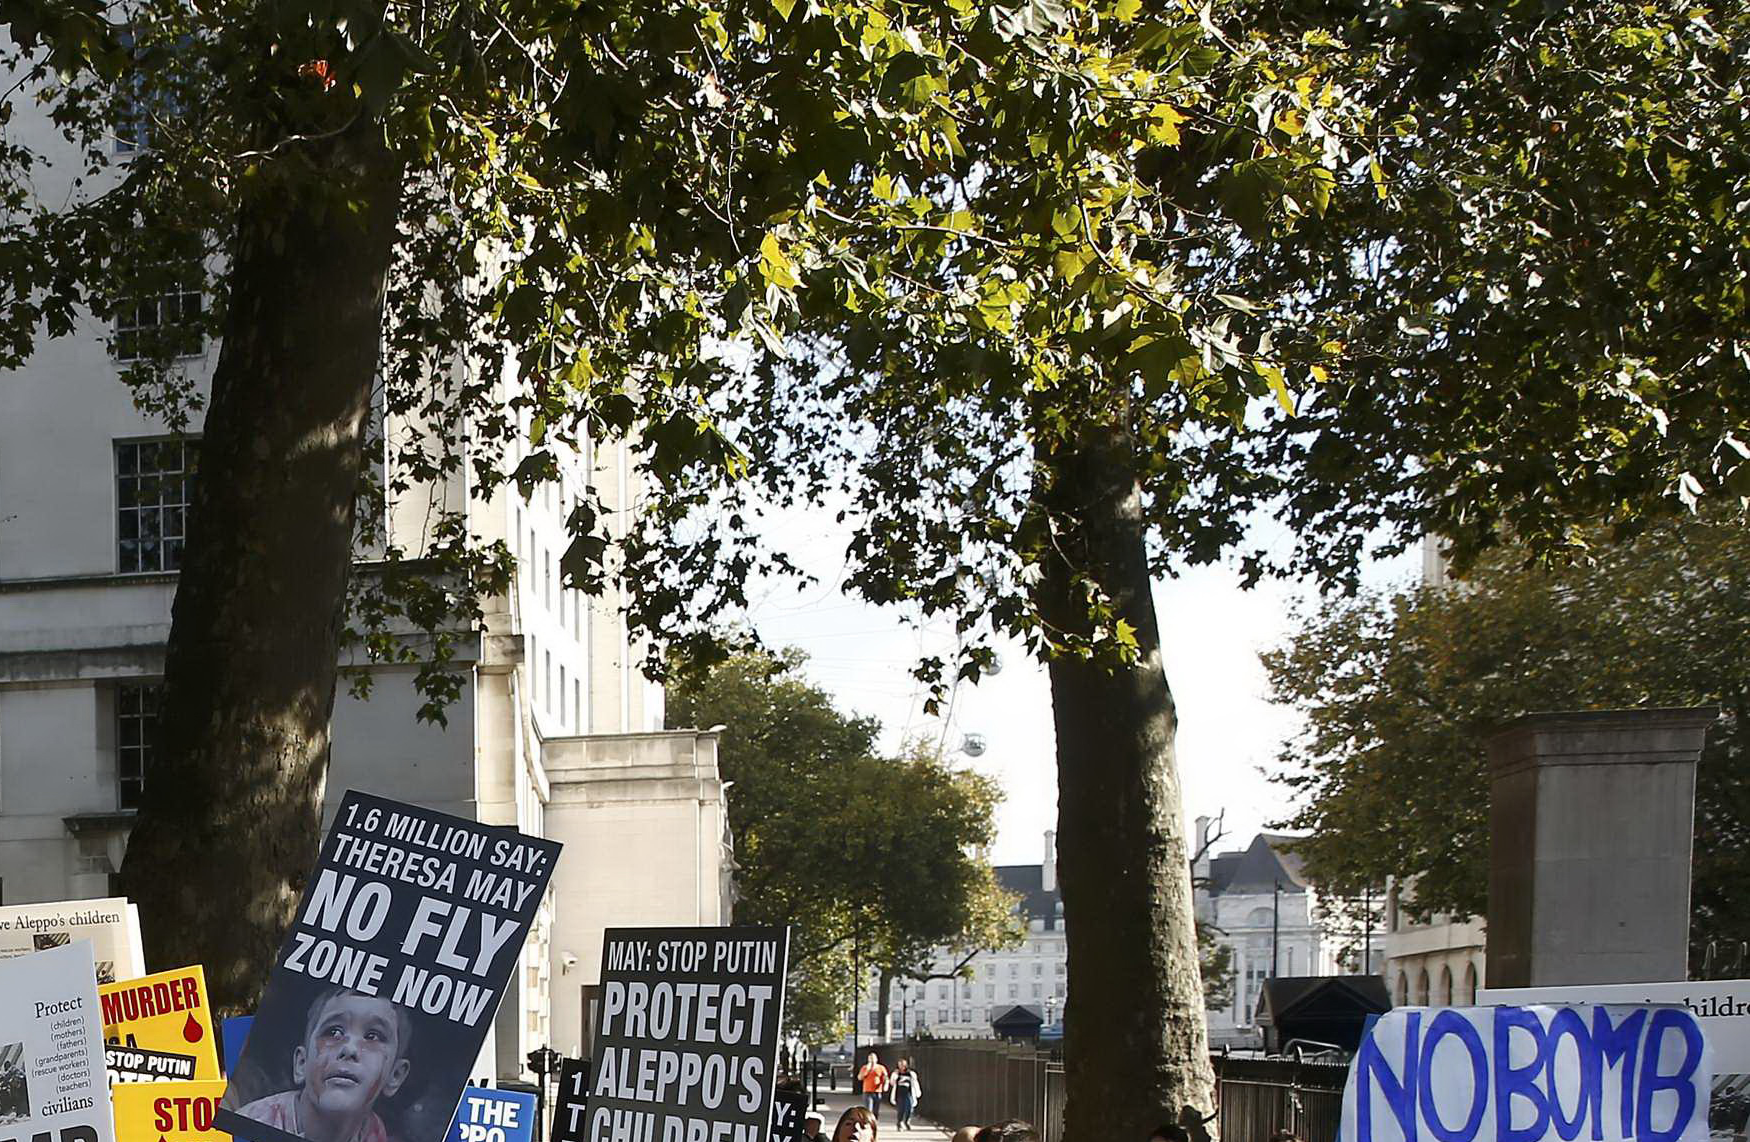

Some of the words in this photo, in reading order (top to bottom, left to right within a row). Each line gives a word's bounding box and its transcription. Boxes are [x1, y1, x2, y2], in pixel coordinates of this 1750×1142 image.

[345, 803, 382, 832] 1.6
[384, 813, 488, 861] MILLION
[490, 840, 547, 876] SAY:
[332, 833, 458, 893] THERESA
[463, 869, 536, 913] MAY
[69, 910, 120, 926] children
[302, 868, 392, 942] NO
[400, 895, 521, 978] FLY
[283, 932, 389, 996] ZONE
[391, 965, 494, 1027] NOW
[607, 941, 651, 971] MAY:
[656, 940, 707, 973] STOP
[713, 941, 777, 974] PUTIN
[34, 997, 82, 1018] Protect
[100, 976, 200, 1025] MURDER
[601, 981, 773, 1046] PROTECT
[106, 1050, 145, 1069] STOP
[147, 1055, 191, 1076] PUTIN
[595, 1046, 765, 1114] ALEPPO'S
[41, 1095, 94, 1117] civilians
[467, 1097, 521, 1129] THE
